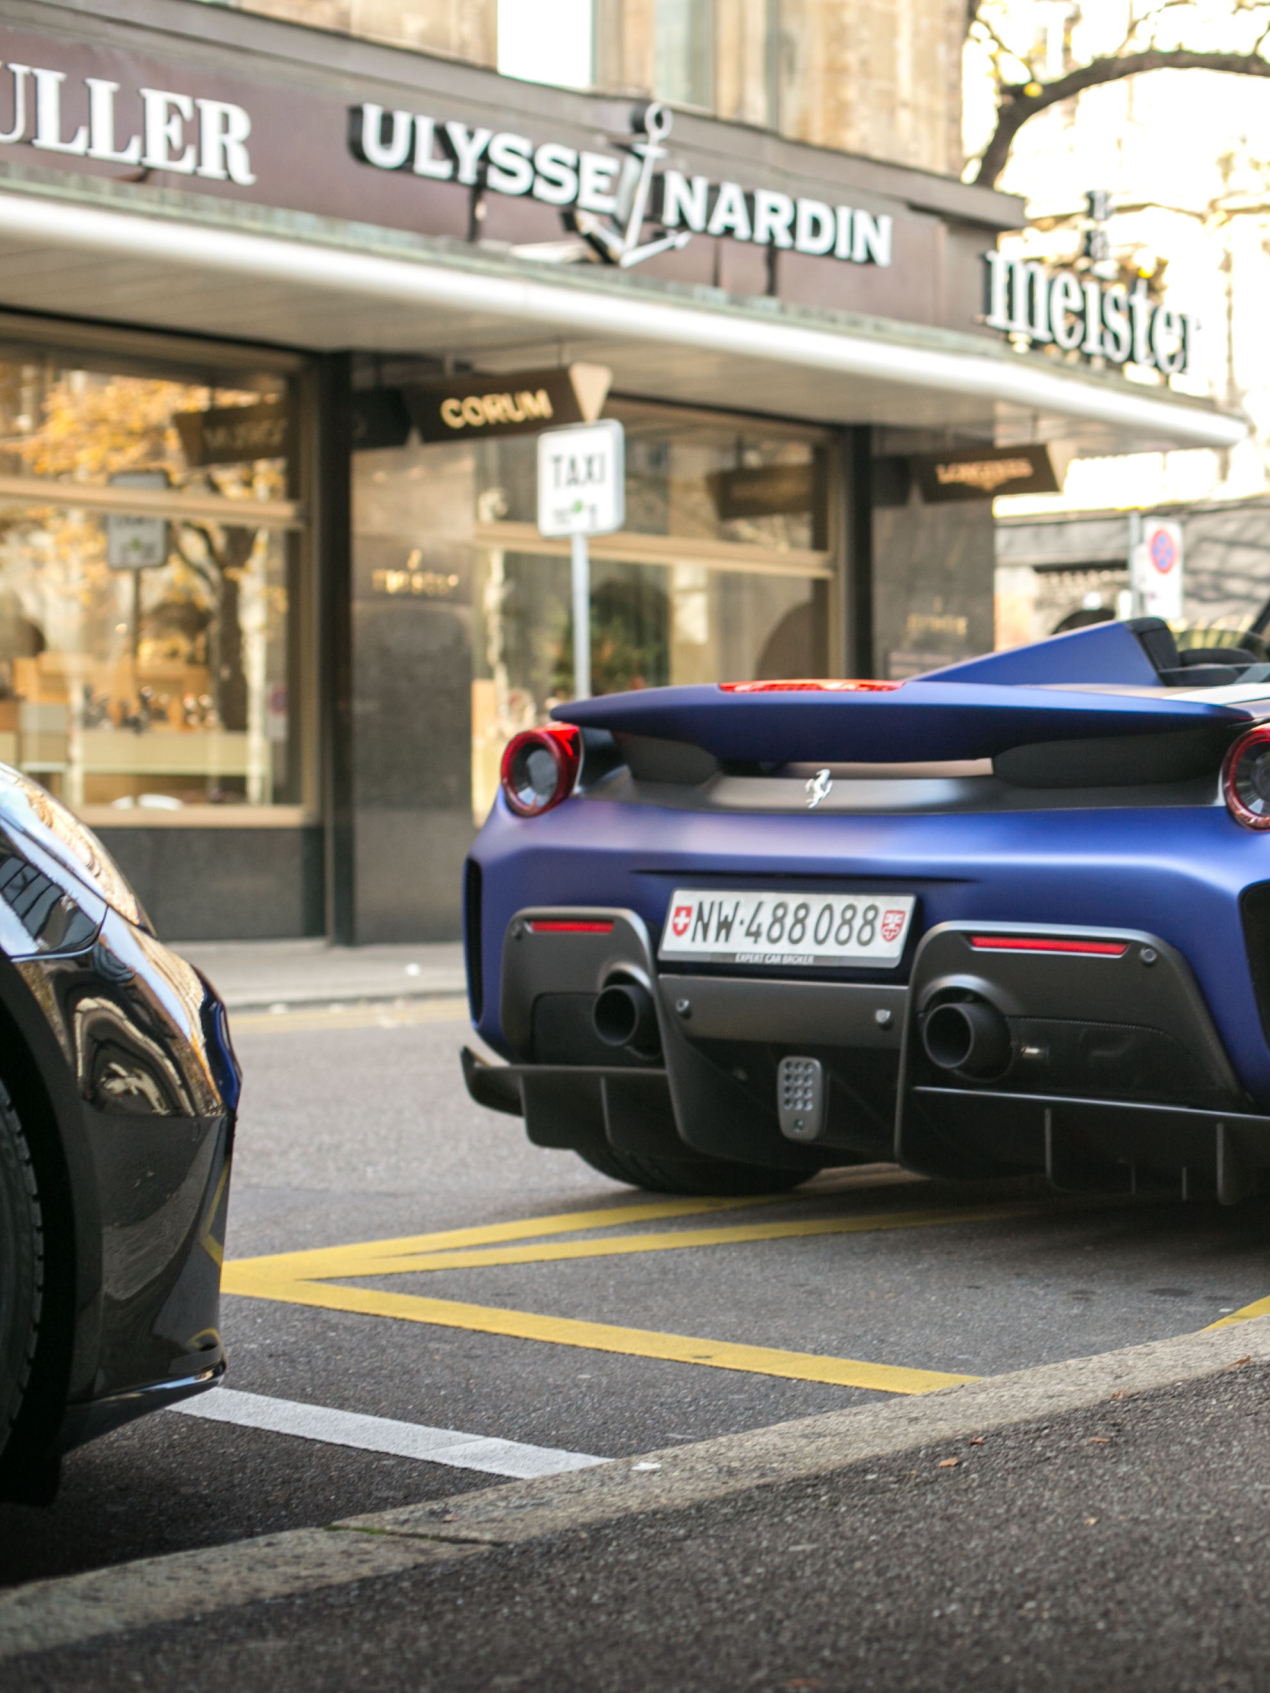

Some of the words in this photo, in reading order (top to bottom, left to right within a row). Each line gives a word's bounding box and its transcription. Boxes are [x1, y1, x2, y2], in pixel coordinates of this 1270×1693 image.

[361, 102, 620, 214] ULYSSE
[661, 169, 893, 267] NARDIN
[984, 251, 1202, 375] meister
[441, 389, 553, 429] CORUM
[551, 452, 606, 489] TAXI
[735, 952, 764, 964] EXPERT
[764, 953, 782, 965] CAR
[782, 954, 815, 966] BROKER
